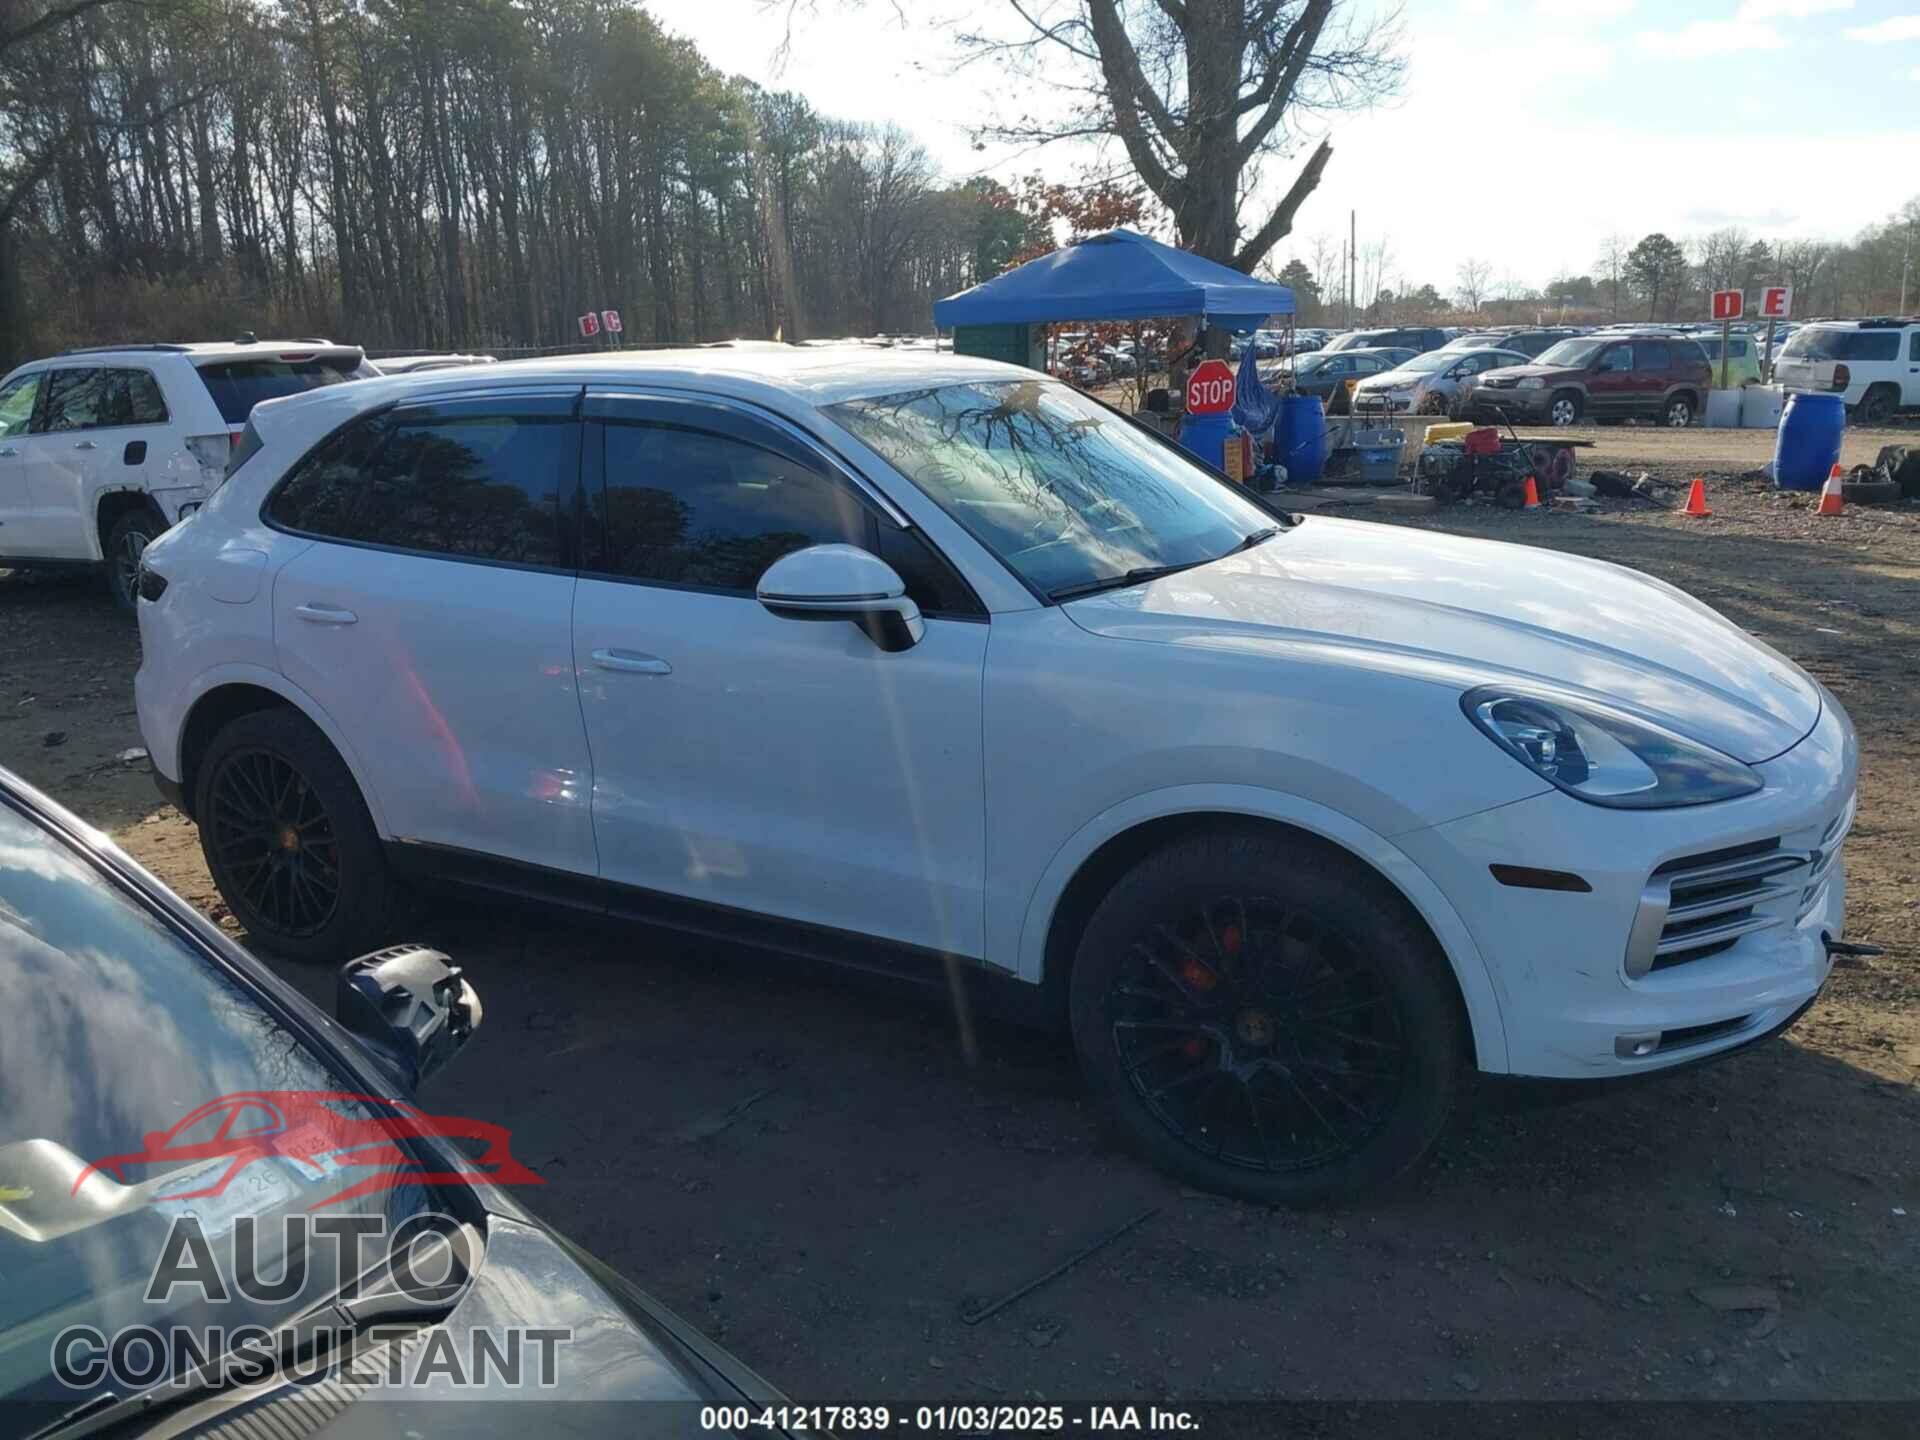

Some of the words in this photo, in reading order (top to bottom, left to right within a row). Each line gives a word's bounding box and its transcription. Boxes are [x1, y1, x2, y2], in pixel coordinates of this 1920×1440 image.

[1714, 292, 1741, 318] D
[1765, 289, 1786, 314] E
[1191, 379, 1233, 406] STOP
